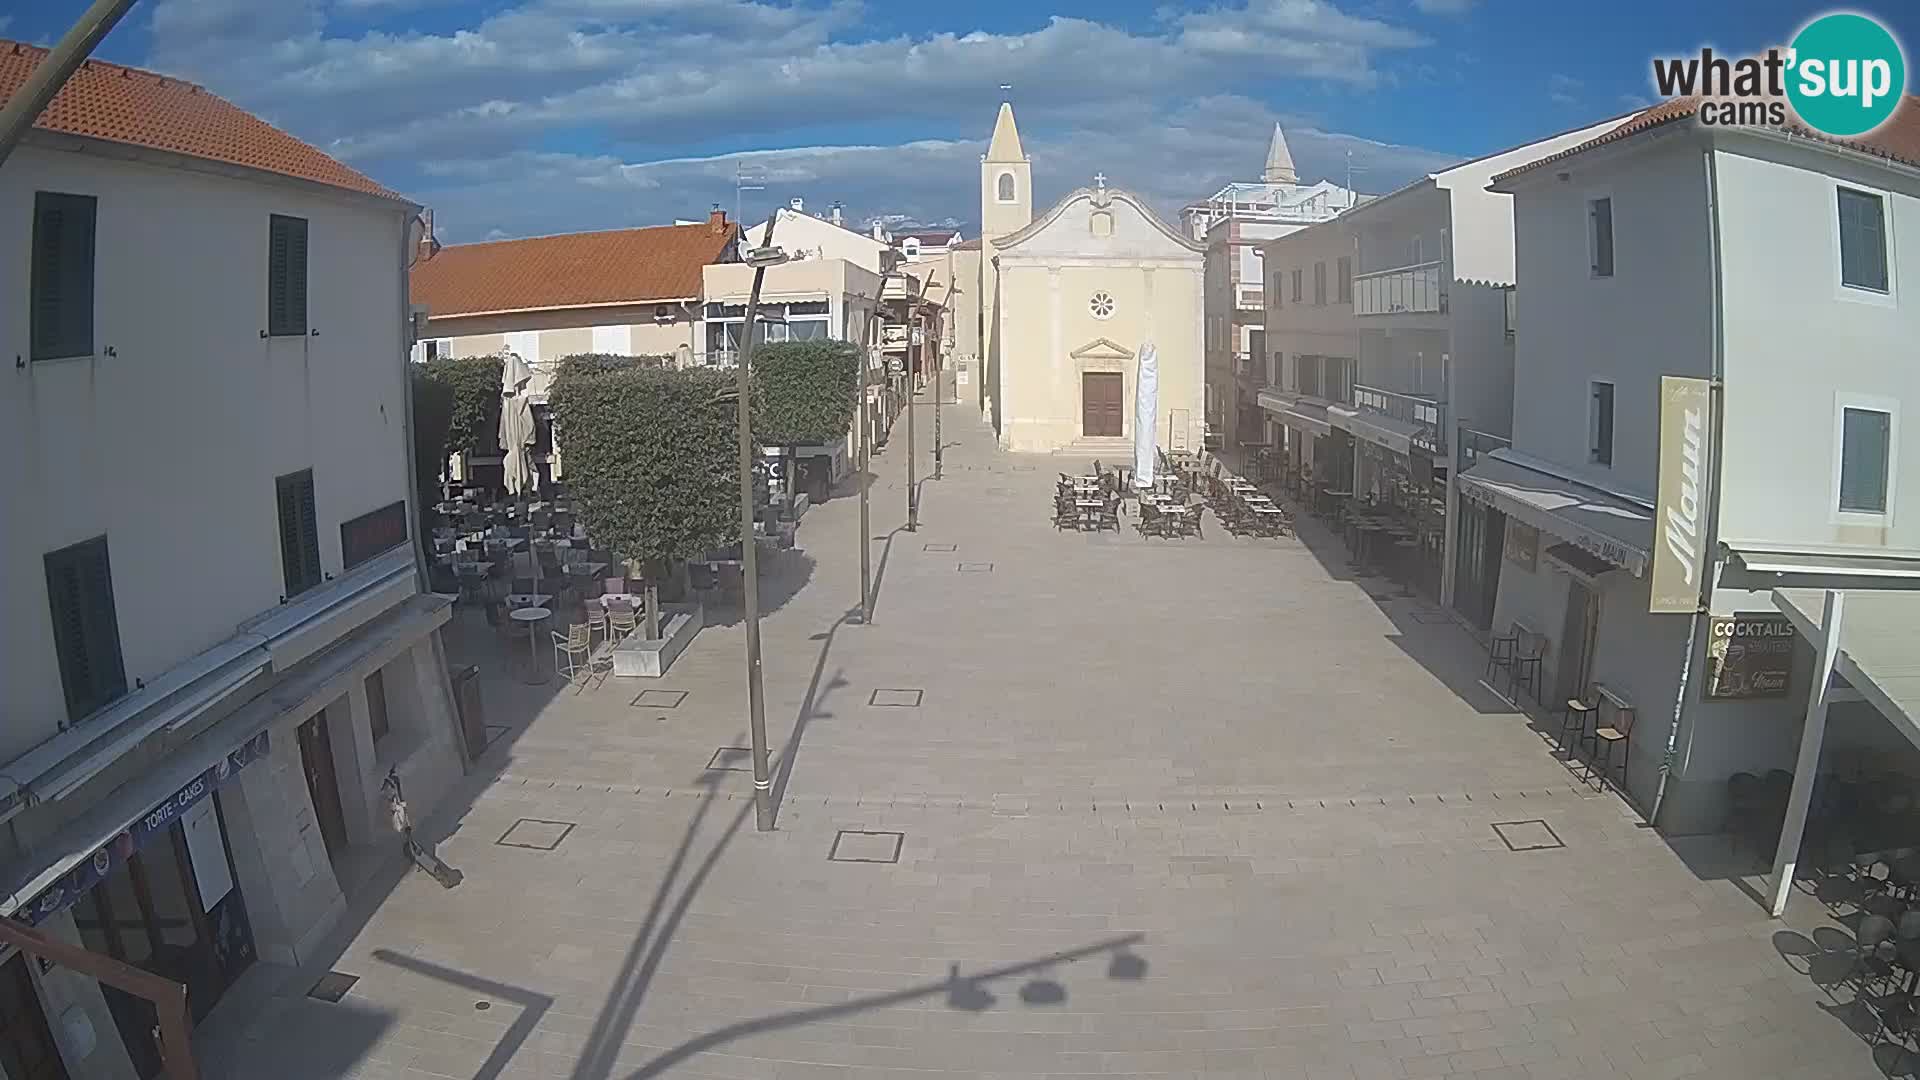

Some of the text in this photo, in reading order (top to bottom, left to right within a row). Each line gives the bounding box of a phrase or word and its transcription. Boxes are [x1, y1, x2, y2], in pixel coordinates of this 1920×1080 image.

[1665, 407, 1701, 585] Maun
[1714, 622, 1794, 637] COCKTAILS
[144, 802, 173, 831] TORTE
[178, 779, 204, 806] CAKES
